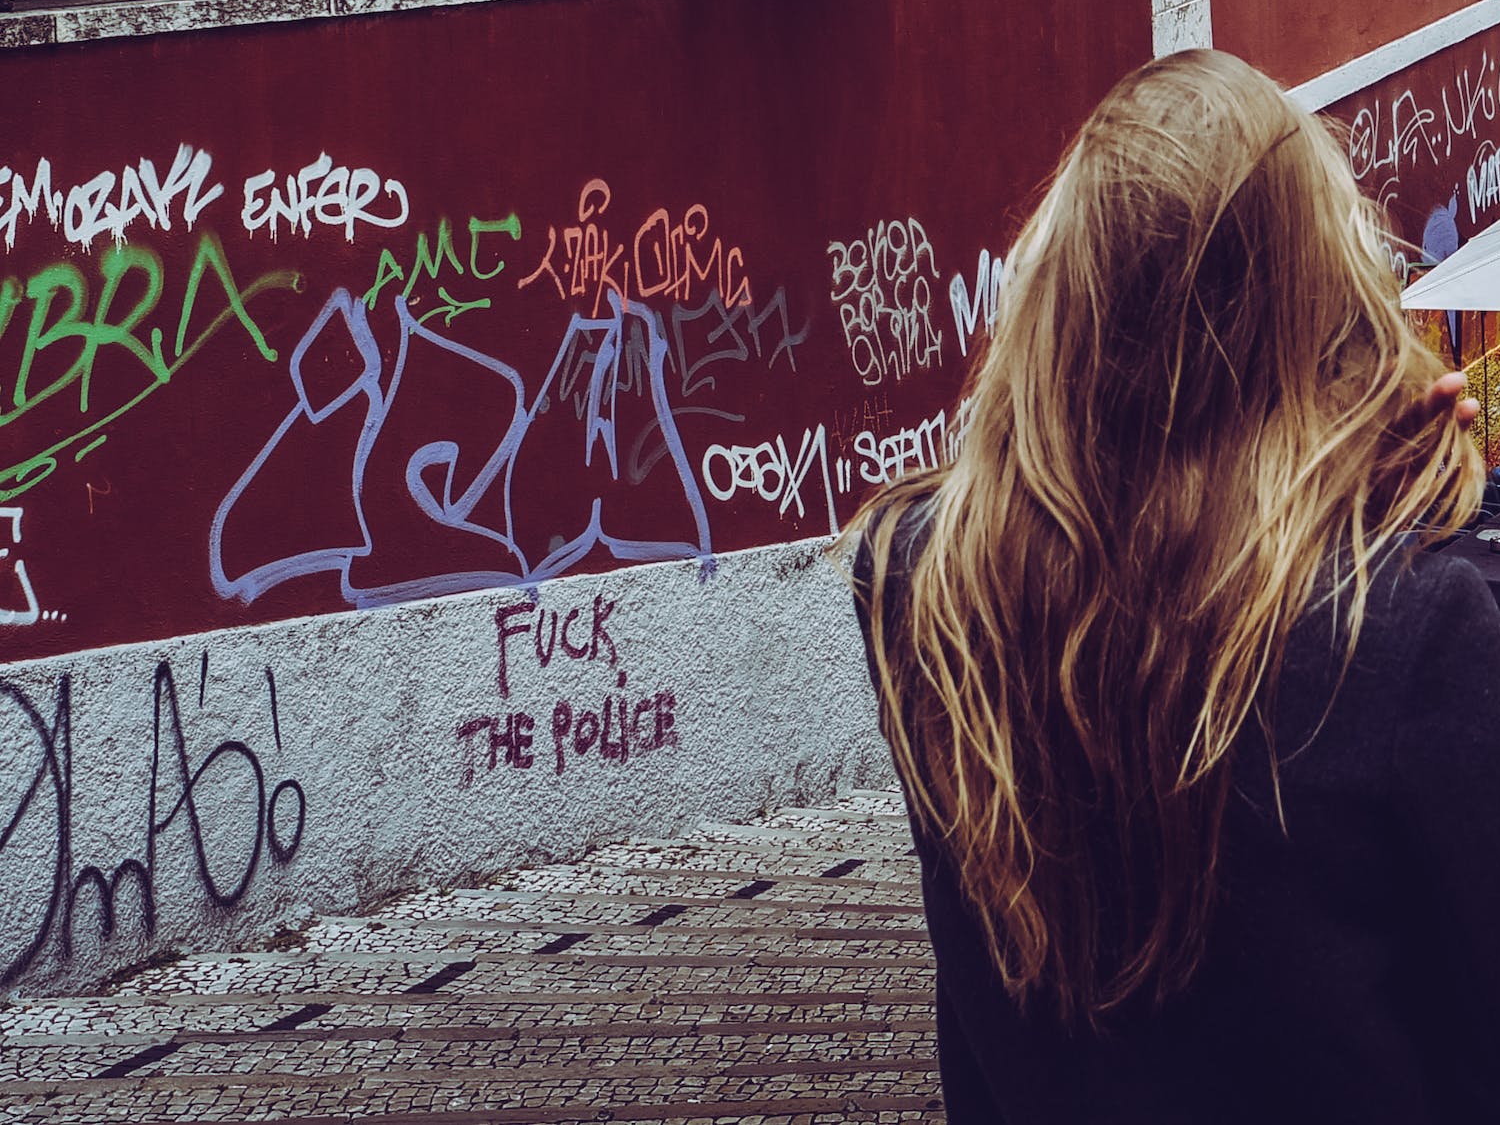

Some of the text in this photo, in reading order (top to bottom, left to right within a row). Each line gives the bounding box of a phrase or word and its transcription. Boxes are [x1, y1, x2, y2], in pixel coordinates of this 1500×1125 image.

[494, 594, 618, 699] FUCK
[456, 671, 679, 790] THE POLICE
